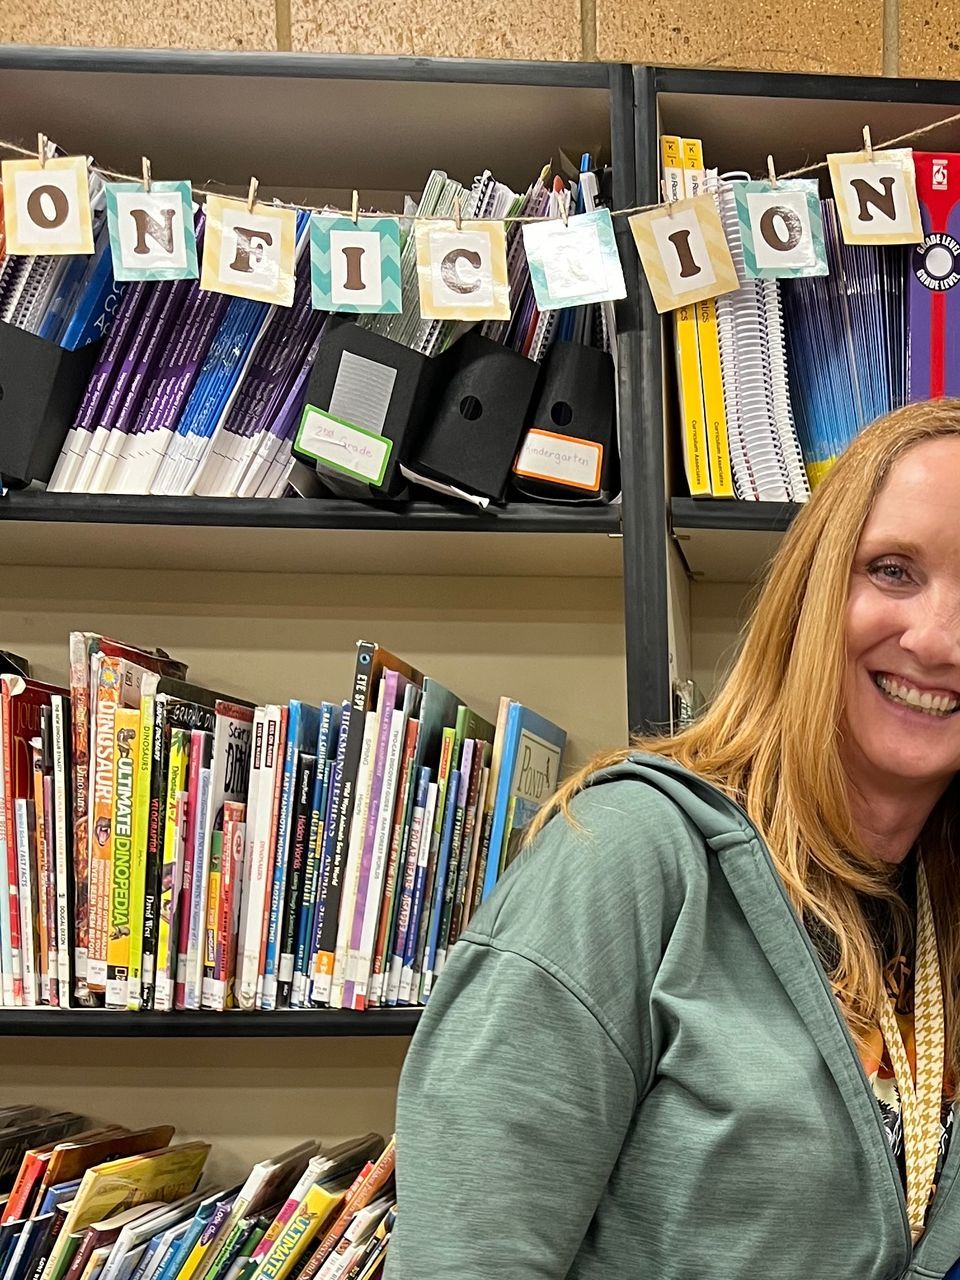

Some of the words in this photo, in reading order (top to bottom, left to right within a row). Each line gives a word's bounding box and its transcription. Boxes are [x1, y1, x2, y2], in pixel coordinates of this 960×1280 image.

[915, 268, 941, 291] GRADE
[341, 436, 374, 459] Grade
[688, 419, 701, 453] Curriculum
[711, 421, 723, 455] Curriculum
[691, 453, 703, 485] Associates
[714, 455, 726, 487] Associates
[355, 674, 368, 692] EYE
[353, 693, 365, 712] SPY
[140, 726, 152, 771] DINOSAURS
[167, 765, 180, 800] Dinosaur
[384, 757, 397, 790] DISCOVERY
[516, 744, 543, 799] POND
[74, 764, 87, 811] Dinosaurs
[115, 757, 134, 838] ULTIMATE
[149, 798, 159, 853] VELOCIRAPTOR
[276, 793, 290, 835] MAMMOTH
[294, 814, 306, 842] Hidden
[274, 836, 285, 867] MUMMY
[292, 843, 304, 869] Worlds
[407, 829, 422, 859] POLAR
[112, 838, 132, 927] DINOPEDIA
[403, 861, 416, 889] BEARS
[144, 895, 155, 919] David
[269, 880, 280, 910] FROZEN
[143, 920, 154, 938] West
[261, 1212, 310, 1279] ULTIMATE
[314, 1231, 340, 1261] Insects
[304, 1257, 321, 1275] and
